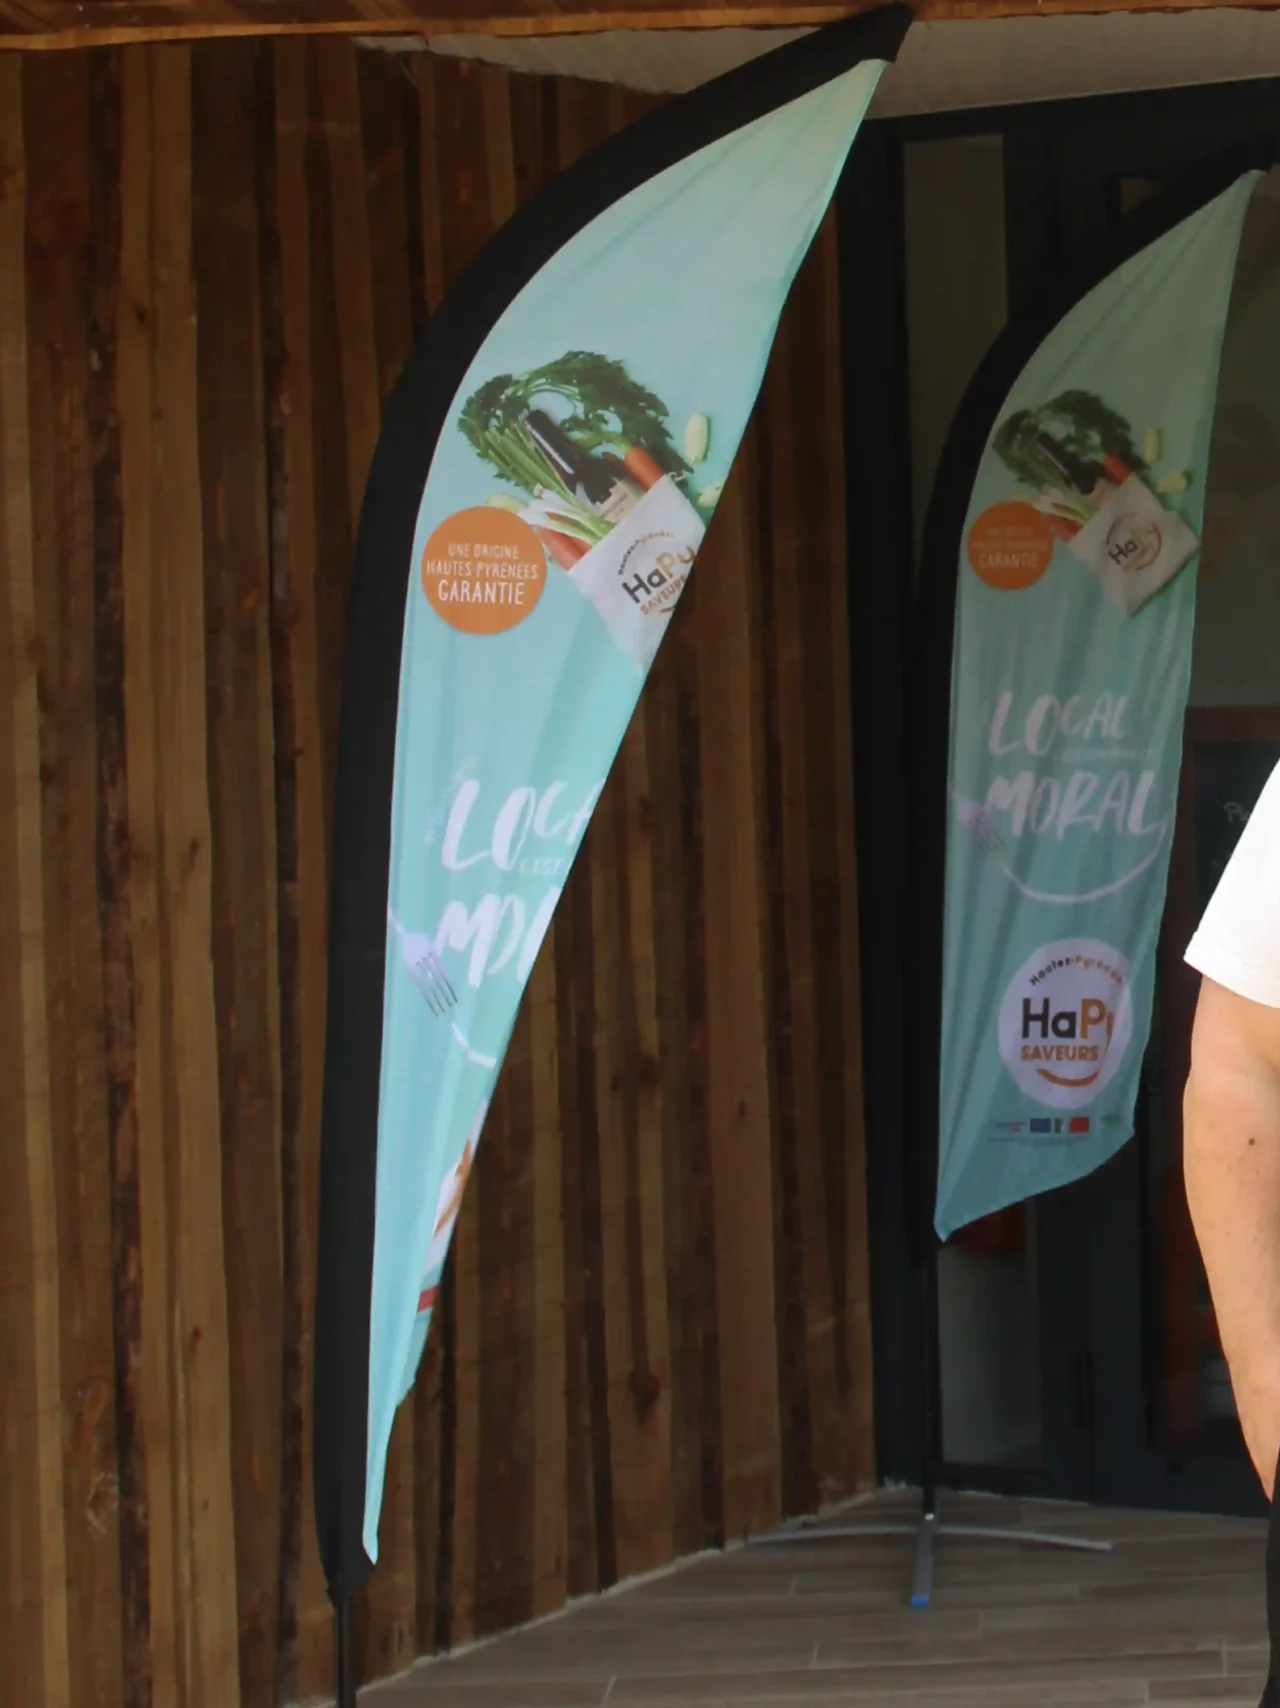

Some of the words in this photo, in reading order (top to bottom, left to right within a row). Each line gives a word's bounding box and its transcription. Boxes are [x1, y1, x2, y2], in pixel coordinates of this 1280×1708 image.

[448, 542, 471, 558] UNE
[473, 543, 520, 560] ORIGINE
[438, 579, 525, 605] GARANTIE
[988, 690, 1134, 756] LOCAL
[984, 769, 1164, 842] MORAL
[1021, 1045, 1099, 1061] SAVEURS
